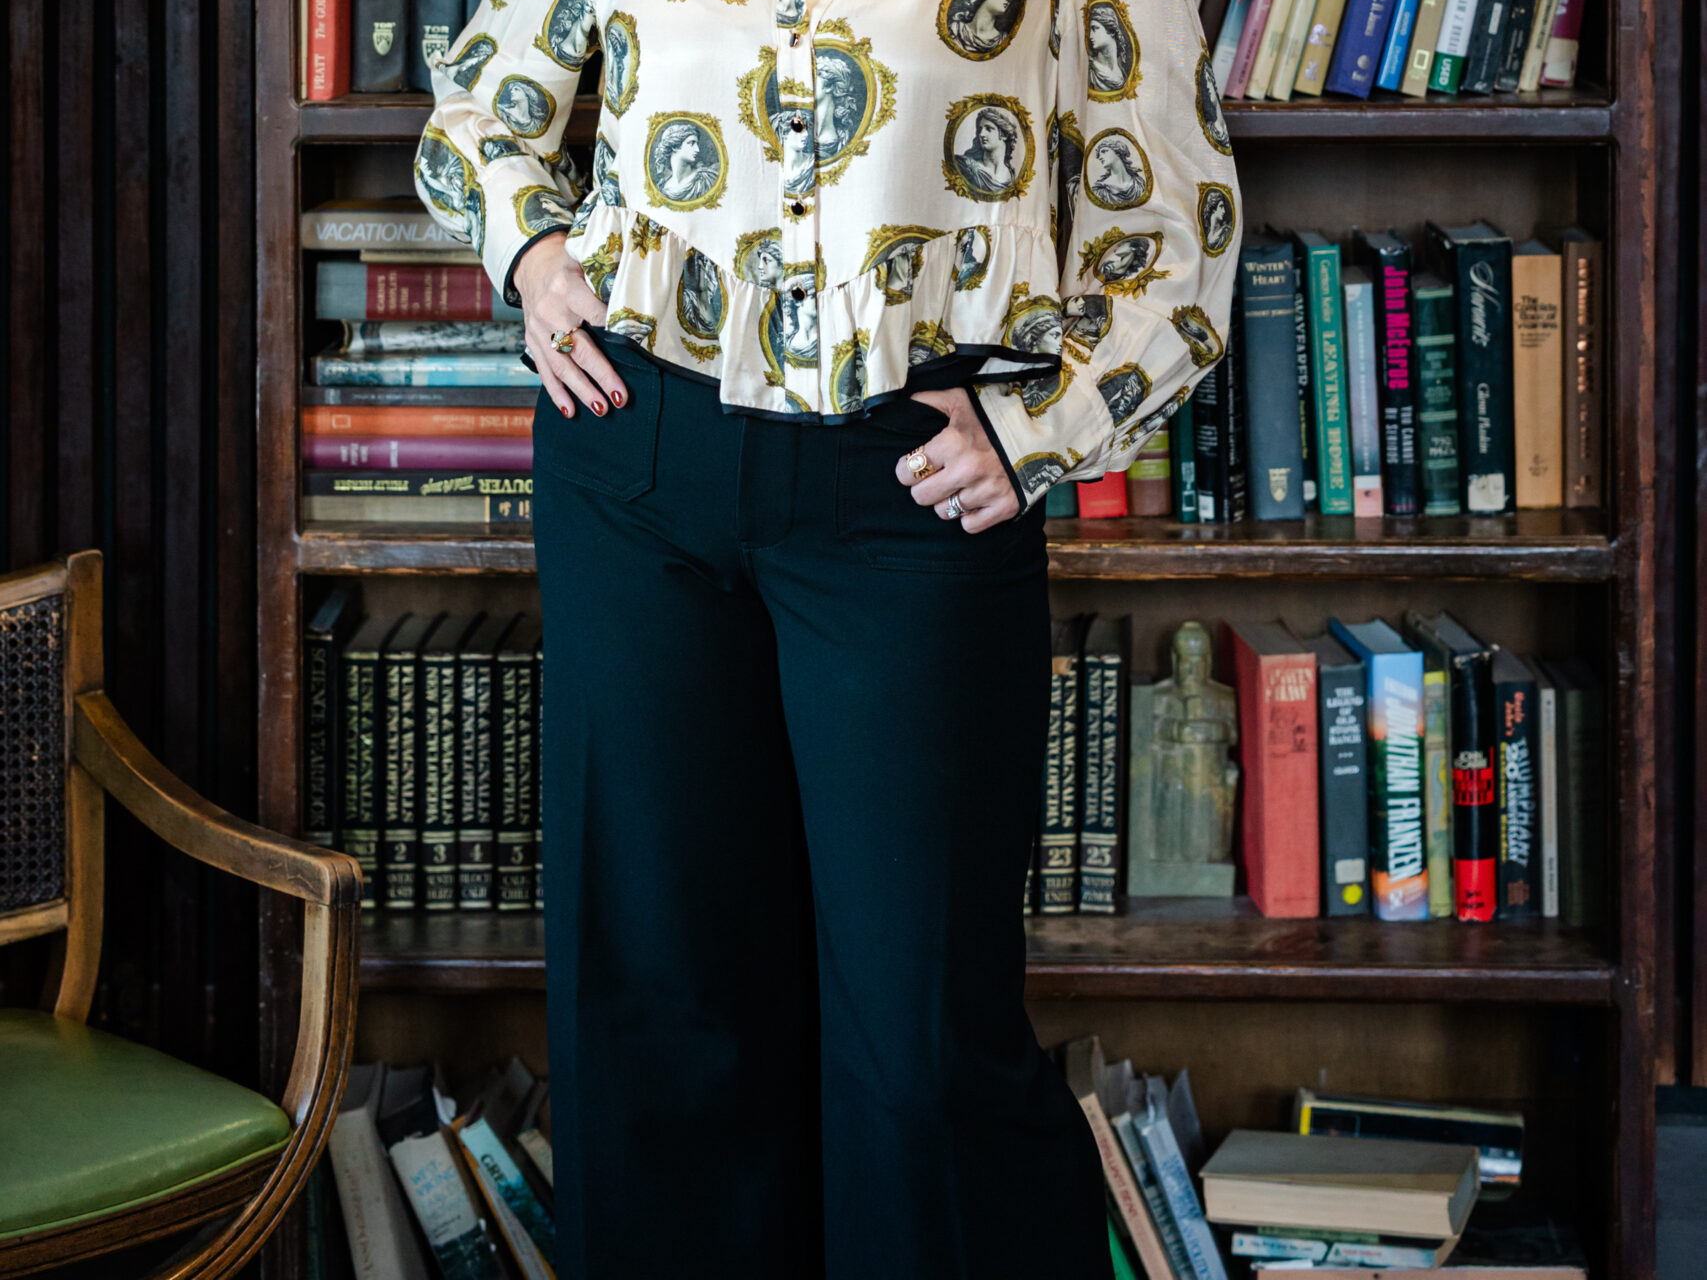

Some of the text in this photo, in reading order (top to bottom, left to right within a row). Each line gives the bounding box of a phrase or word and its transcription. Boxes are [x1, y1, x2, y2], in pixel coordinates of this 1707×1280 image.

[315, 21, 326, 39] The
[313, 52, 326, 90] PRATT
[1436, 57, 1453, 87] USED
[1252, 274, 1287, 286] HEART
[1383, 265, 1411, 390] John McEnroe
[1319, 329, 1345, 491] LEAVING HOME
[401, 666, 414, 712] FUNK
[441, 668, 454, 714] FUNK
[477, 667, 490, 713] FUNK
[519, 668, 530, 714] FUNK
[1103, 669, 1118, 715] FUNK
[306, 647, 327, 826] SCIENCE YEARBOOK
[386, 665, 399, 821] NEW ENCYCLOPEDIA
[426, 667, 438, 823] NEW ENCYCLOPEDIA
[462, 666, 474, 822] NEW ENCYCLOPEDIA
[503, 667, 516, 823] NEW ENCYCLOPEDIA
[1085, 668, 1101, 824] NEW ENCYCLOPEDIA
[401, 732, 414, 822] WAGNALLS
[441, 734, 454, 824] WAGNALLS
[477, 733, 490, 823] WAGNALLS
[519, 734, 530, 824] WAGNALLS
[1100, 735, 1116, 825] WAGNALLS
[1384, 696, 1421, 882] JONATHAN FRANZEN
[394, 843, 407, 862] 2
[433, 844, 446, 863] 3
[470, 844, 482, 862] 4
[511, 846, 524, 864] 5
[1047, 846, 1073, 867] 23
[1086, 846, 1112, 866] 25
